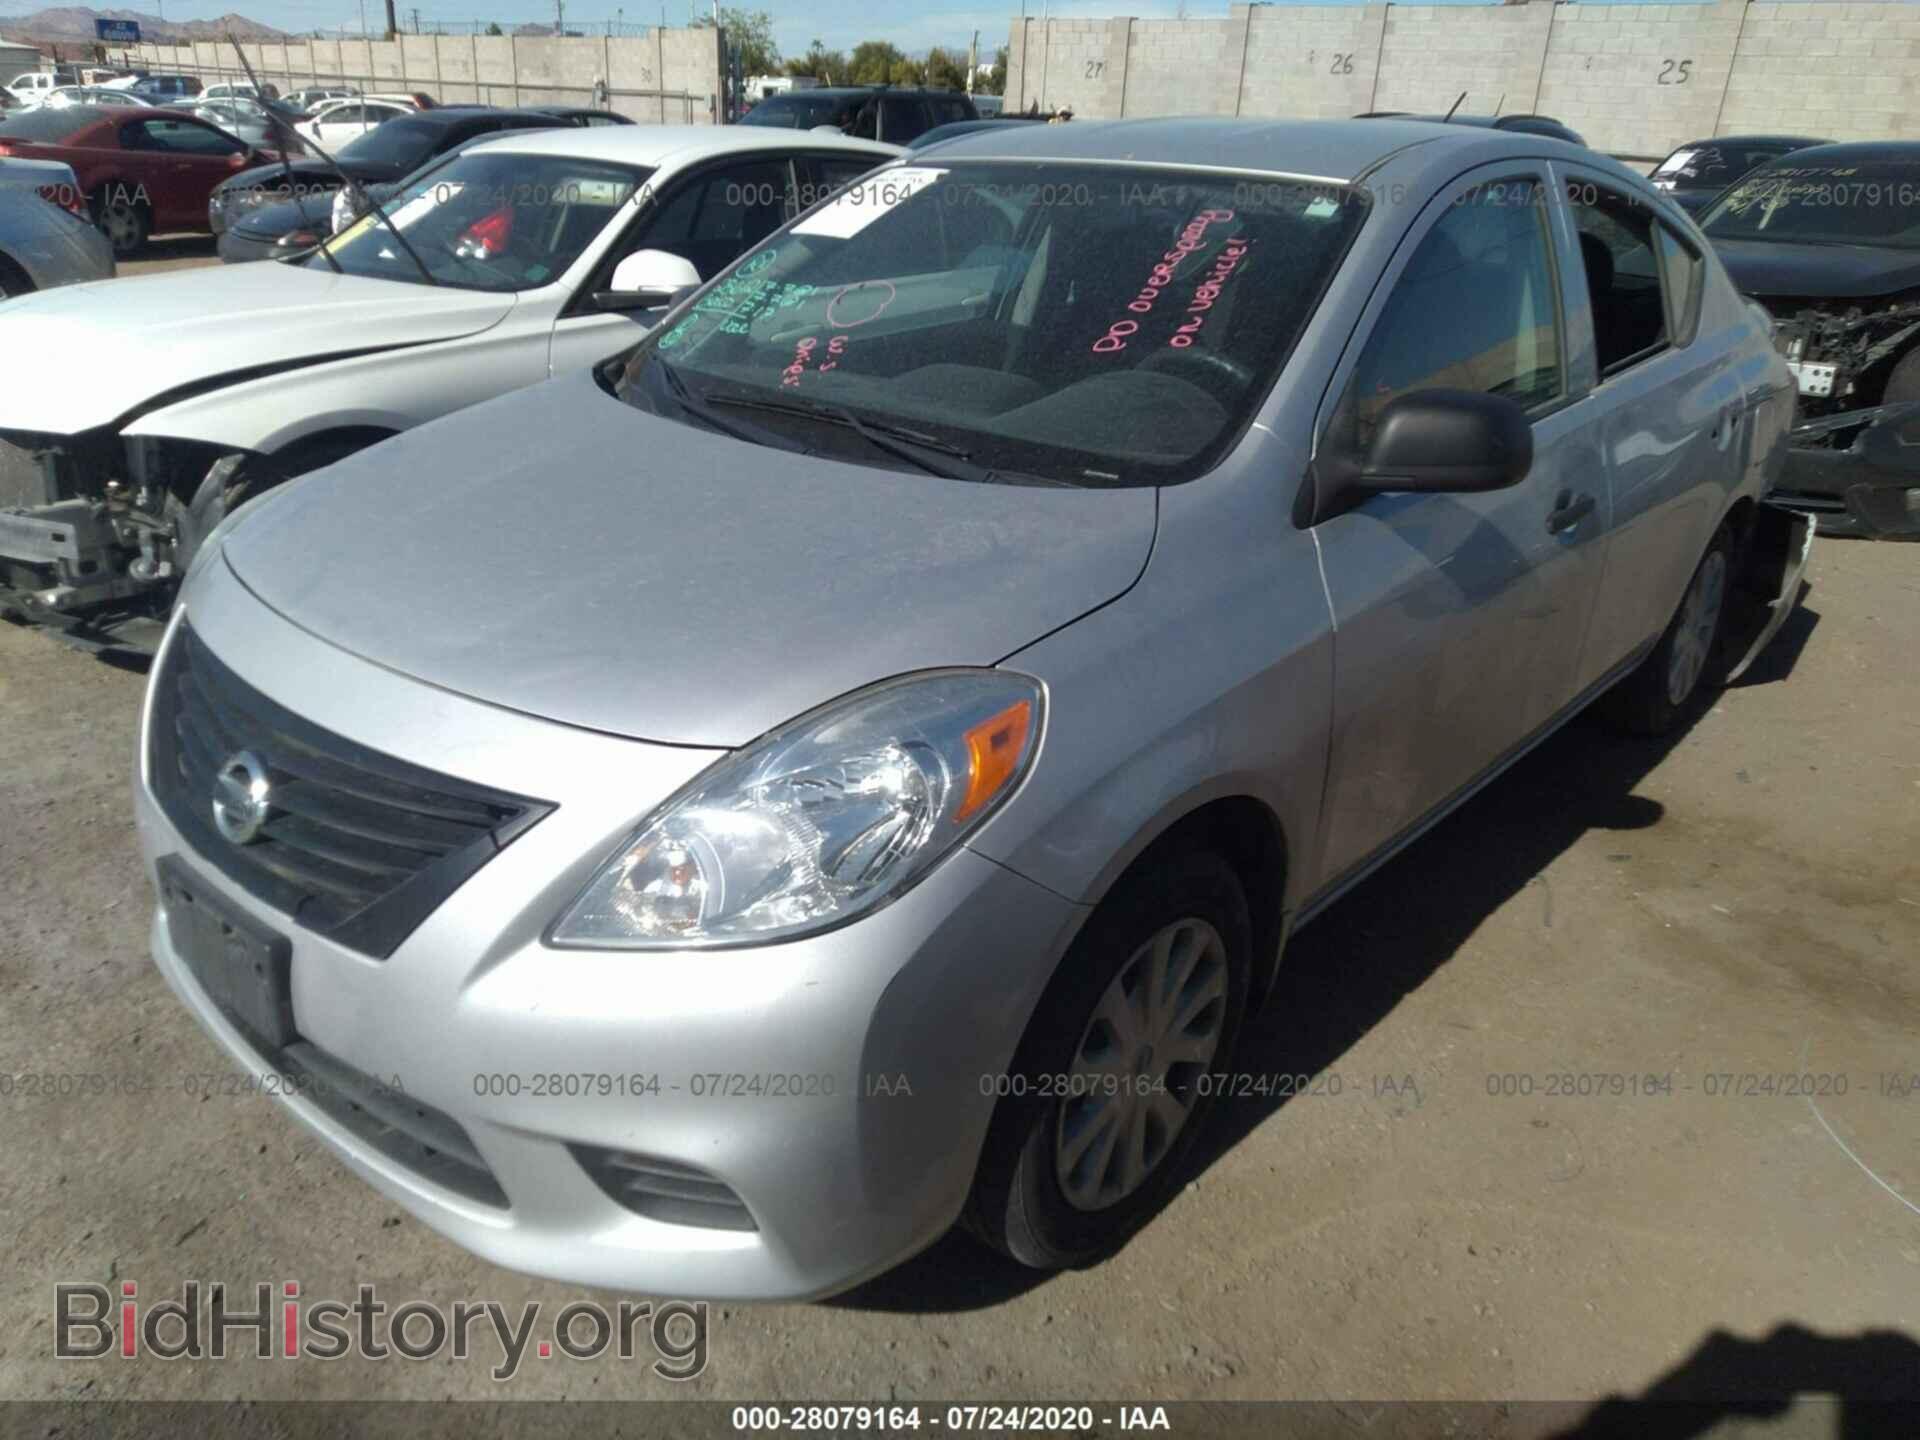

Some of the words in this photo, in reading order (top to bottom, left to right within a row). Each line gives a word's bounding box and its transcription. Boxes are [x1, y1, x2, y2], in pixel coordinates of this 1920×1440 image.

[1085, 60, 1105, 80] 27
[1330, 53, 1354, 75] 26
[1657, 59, 1693, 85] 25
